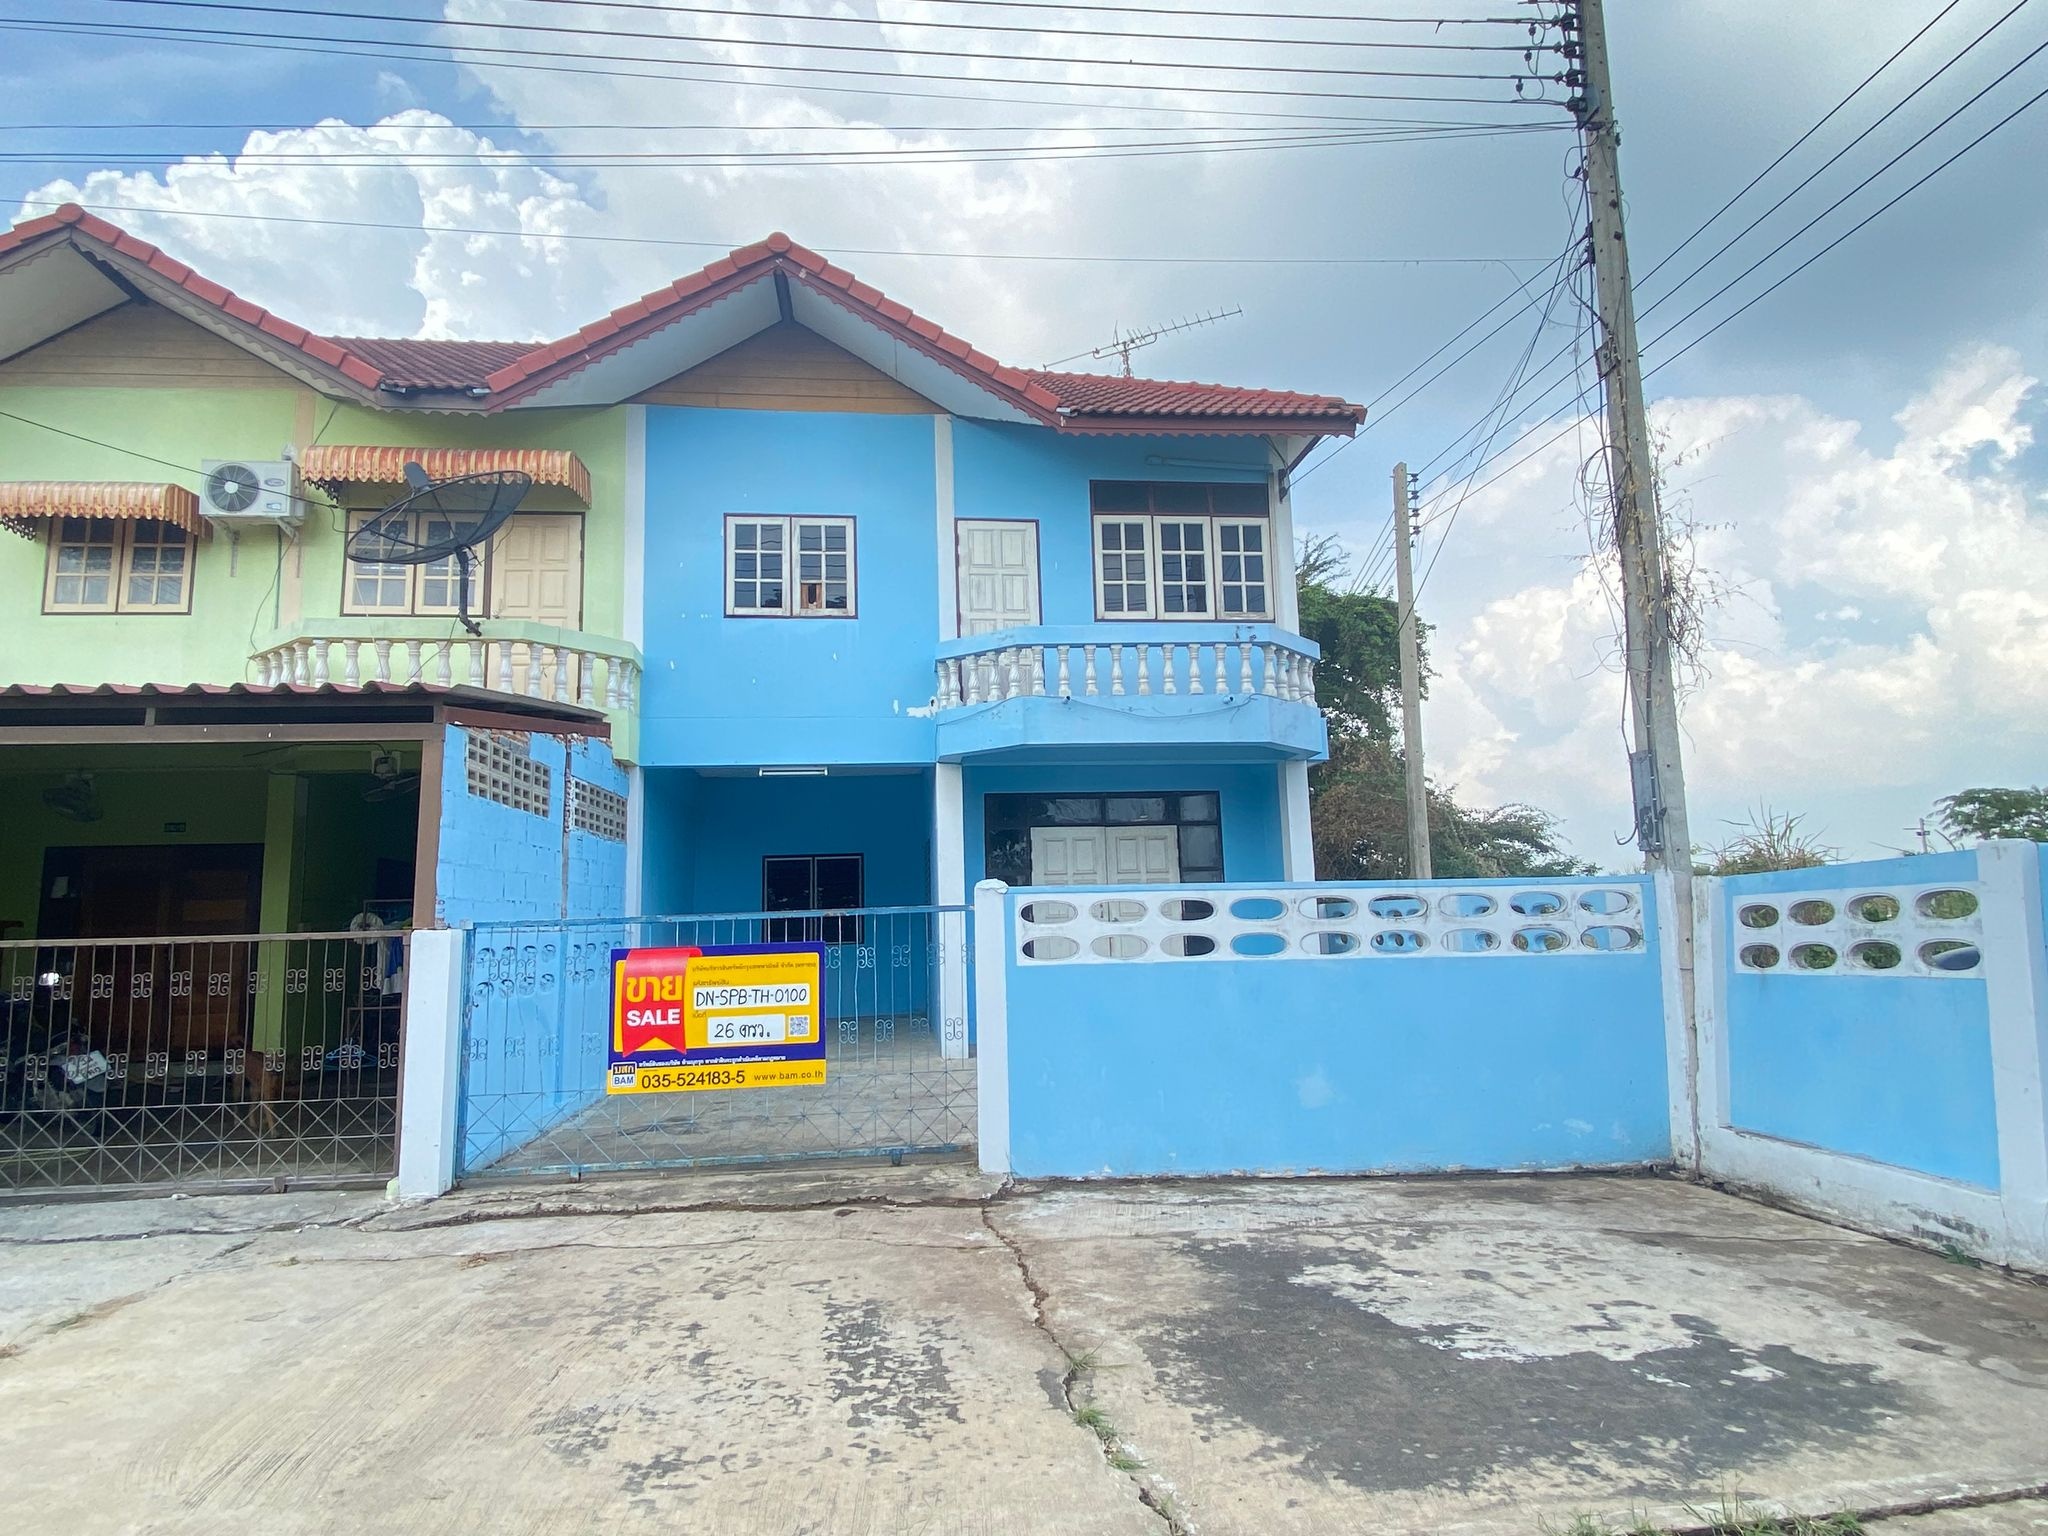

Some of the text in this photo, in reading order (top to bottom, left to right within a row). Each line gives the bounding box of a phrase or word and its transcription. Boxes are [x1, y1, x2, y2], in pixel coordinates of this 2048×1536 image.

[626, 975, 683, 1003] ขาย
[696, 988, 807, 1007] DN-SPB-TH-0100
[626, 1008, 681, 1027] SALE
[714, 1022, 735, 1039] 26
[614, 1076, 634, 1085] BAM
[641, 1070, 823, 1089] 035-524183-5 www.bam.co.th
